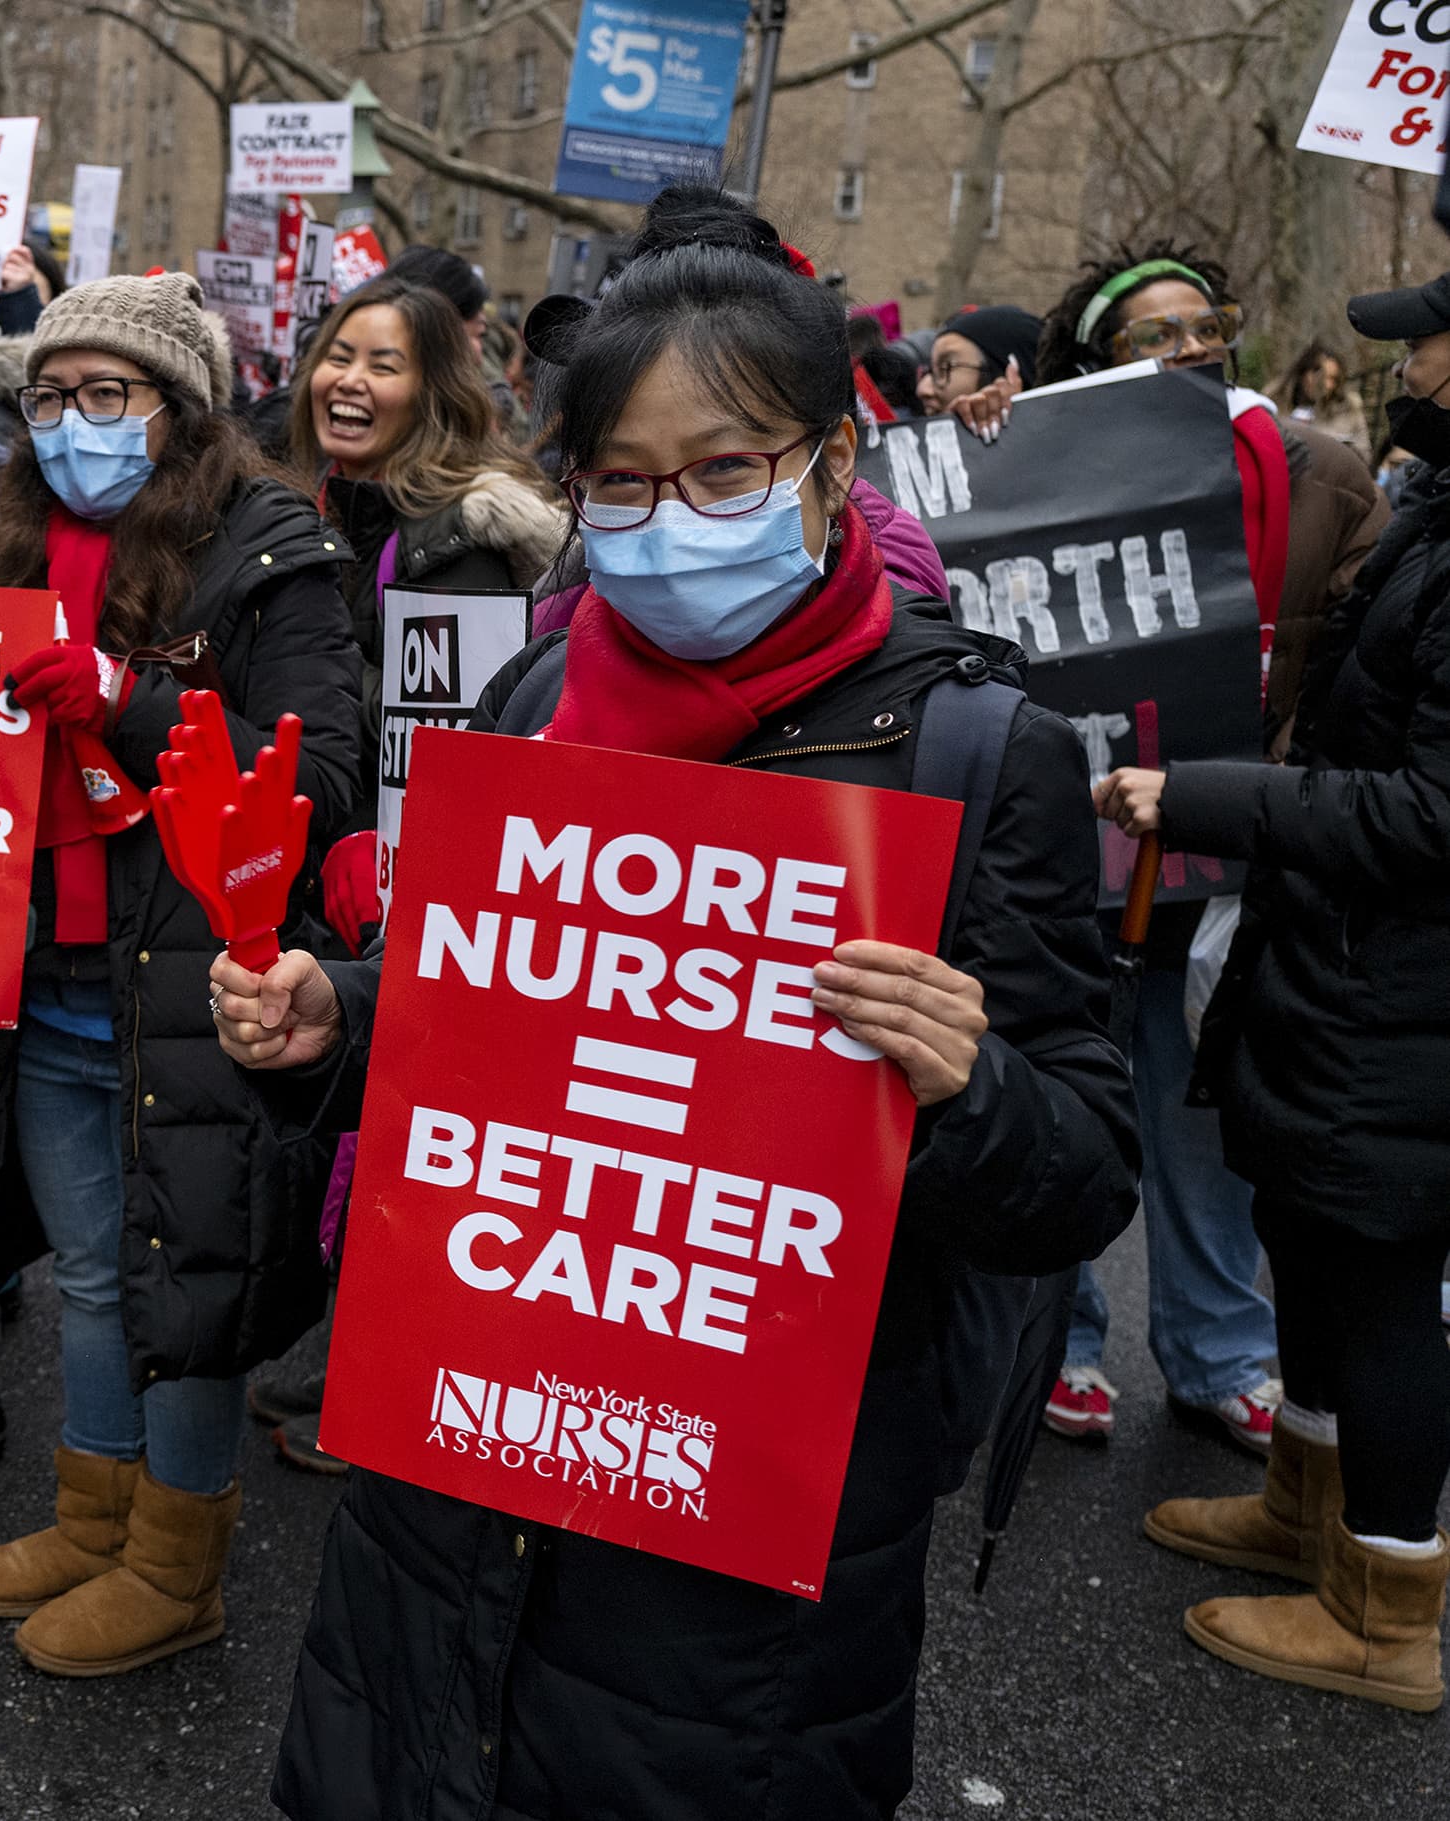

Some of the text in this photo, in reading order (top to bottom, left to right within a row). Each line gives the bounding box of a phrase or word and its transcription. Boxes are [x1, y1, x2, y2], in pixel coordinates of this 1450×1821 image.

[238, 132, 346, 152] CONTRACT
[1390, 106, 1434, 147] &
[949, 528, 1202, 654] ORTH
[403, 627, 450, 694] ON
[496, 815, 847, 948] MORE
[417, 902, 886, 1062] NURSE
[403, 1105, 843, 1279] BETTER
[447, 1211, 757, 1355] CARE
[430, 1367, 715, 1497] NURSES
[534, 1370, 717, 1440] New York State
[426, 1424, 706, 1520] ASSOCIATION
